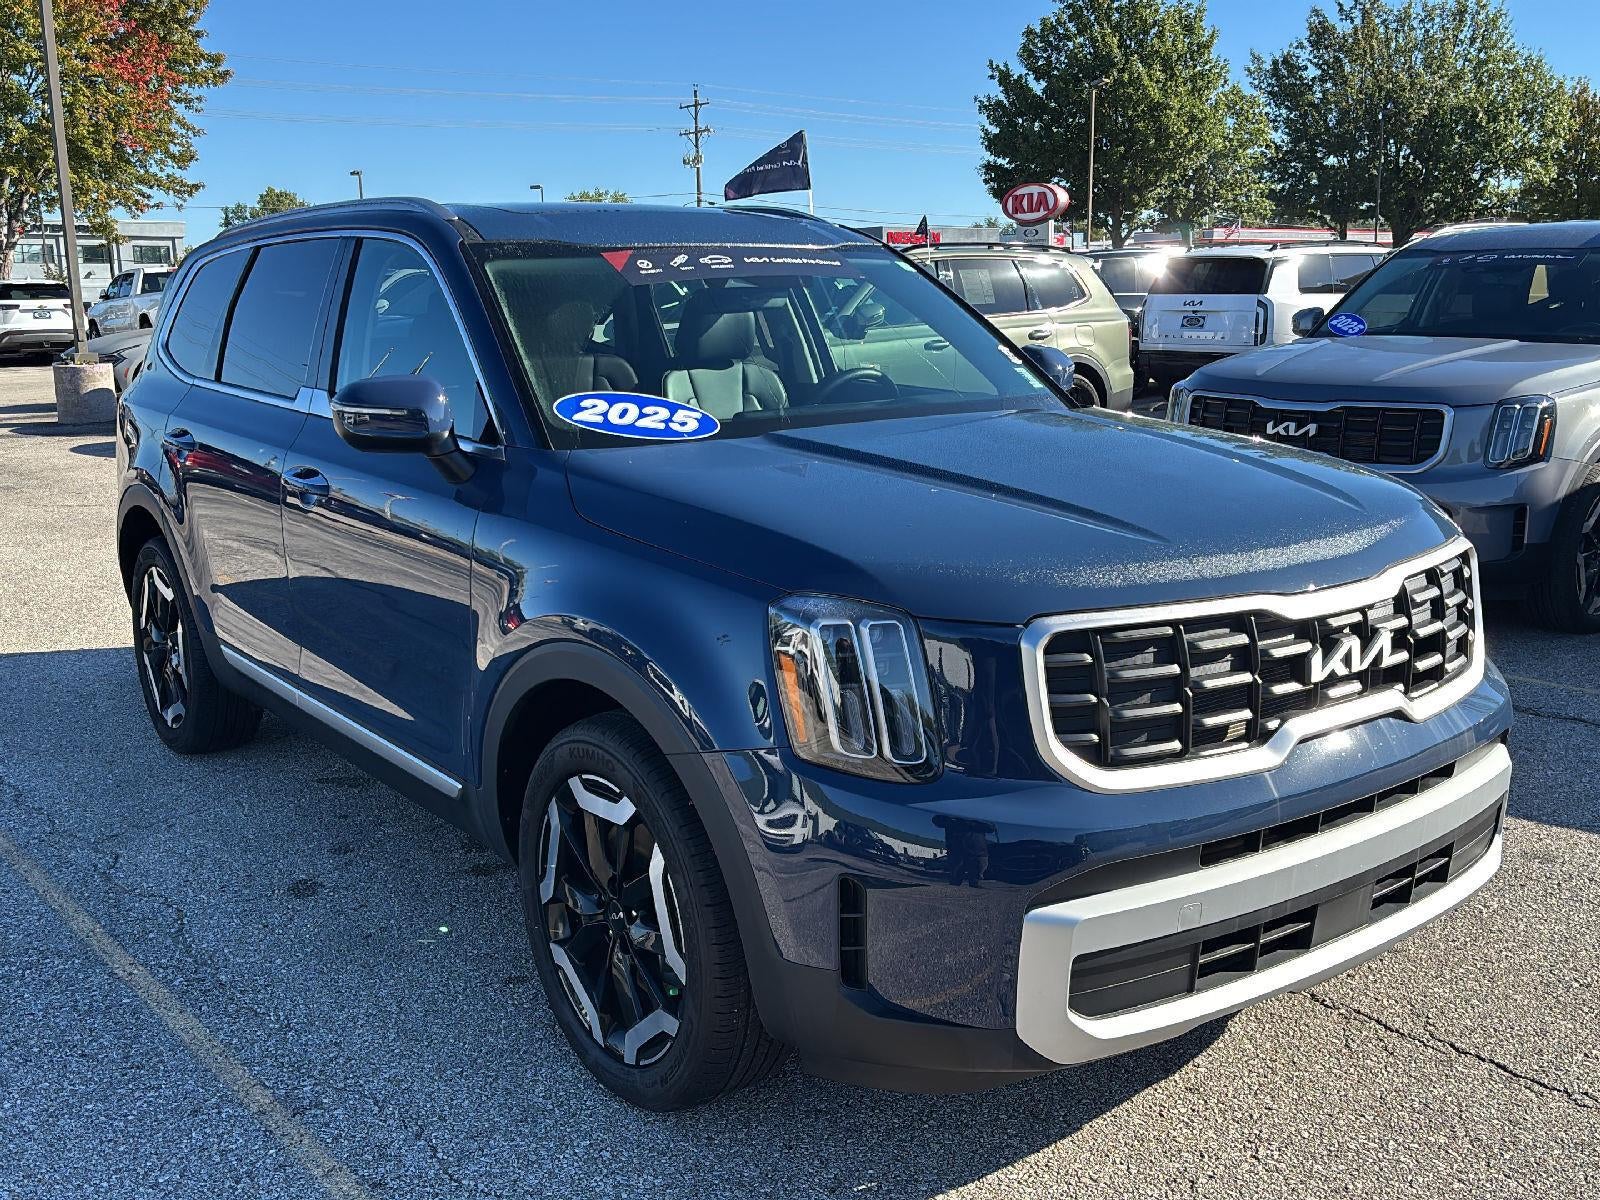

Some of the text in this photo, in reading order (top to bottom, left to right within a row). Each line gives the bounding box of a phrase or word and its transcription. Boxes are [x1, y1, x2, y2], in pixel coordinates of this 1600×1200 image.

[1011, 191, 1050, 215] KIA
[1329, 315, 1365, 334] 2025
[572, 398, 702, 433] 2025
[1266, 420, 1319, 437] KIA
[1305, 626, 1392, 684] KIA
[568, 747, 617, 772] KUMHO
